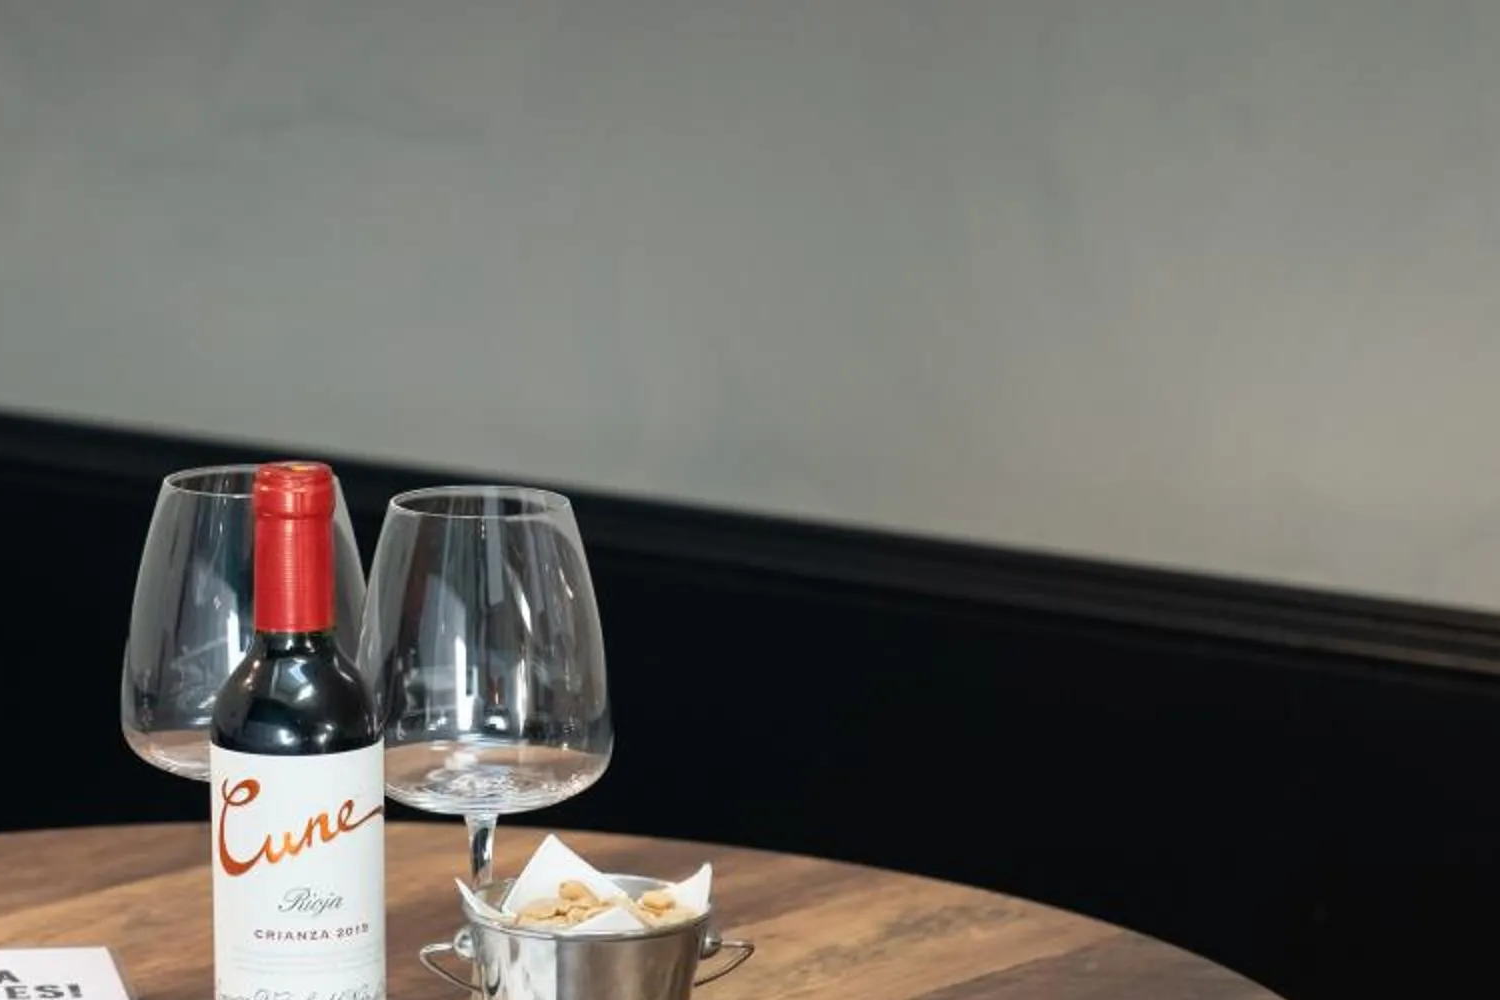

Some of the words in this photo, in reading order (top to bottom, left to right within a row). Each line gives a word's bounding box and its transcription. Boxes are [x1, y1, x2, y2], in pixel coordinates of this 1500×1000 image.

[218, 777, 383, 877] Cune
[277, 886, 345, 919] Rioja
[254, 928, 330, 941] CRIANZA
